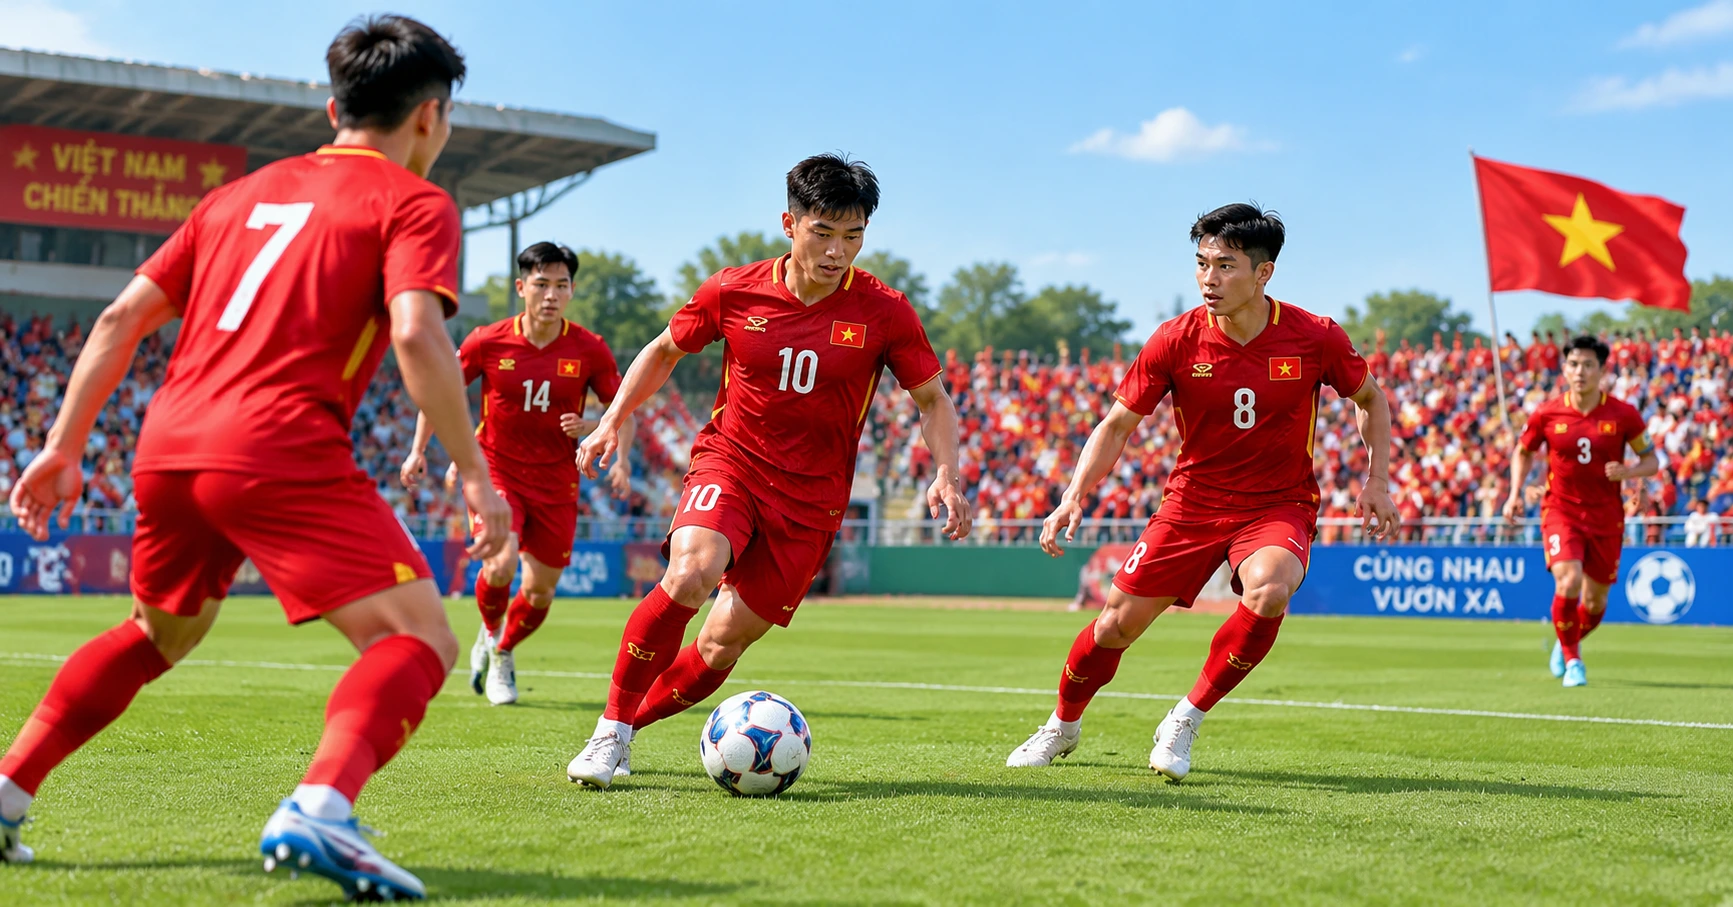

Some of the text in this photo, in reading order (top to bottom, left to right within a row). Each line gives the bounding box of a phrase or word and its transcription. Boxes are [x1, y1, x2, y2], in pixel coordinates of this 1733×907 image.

[124, 150, 187, 181] NAM
[216, 202, 315, 332] 7
[778, 347, 818, 394] 10
[522, 379, 551, 413] 14
[1233, 387, 1256, 430] 8
[1577, 437, 1592, 464] 3
[683, 483, 722, 514] 10
[1123, 541, 1148, 574] 8
[1548, 533, 1561, 556] 3
[1441, 556, 1525, 584] NHAU
[1462, 587, 1505, 614] XA
